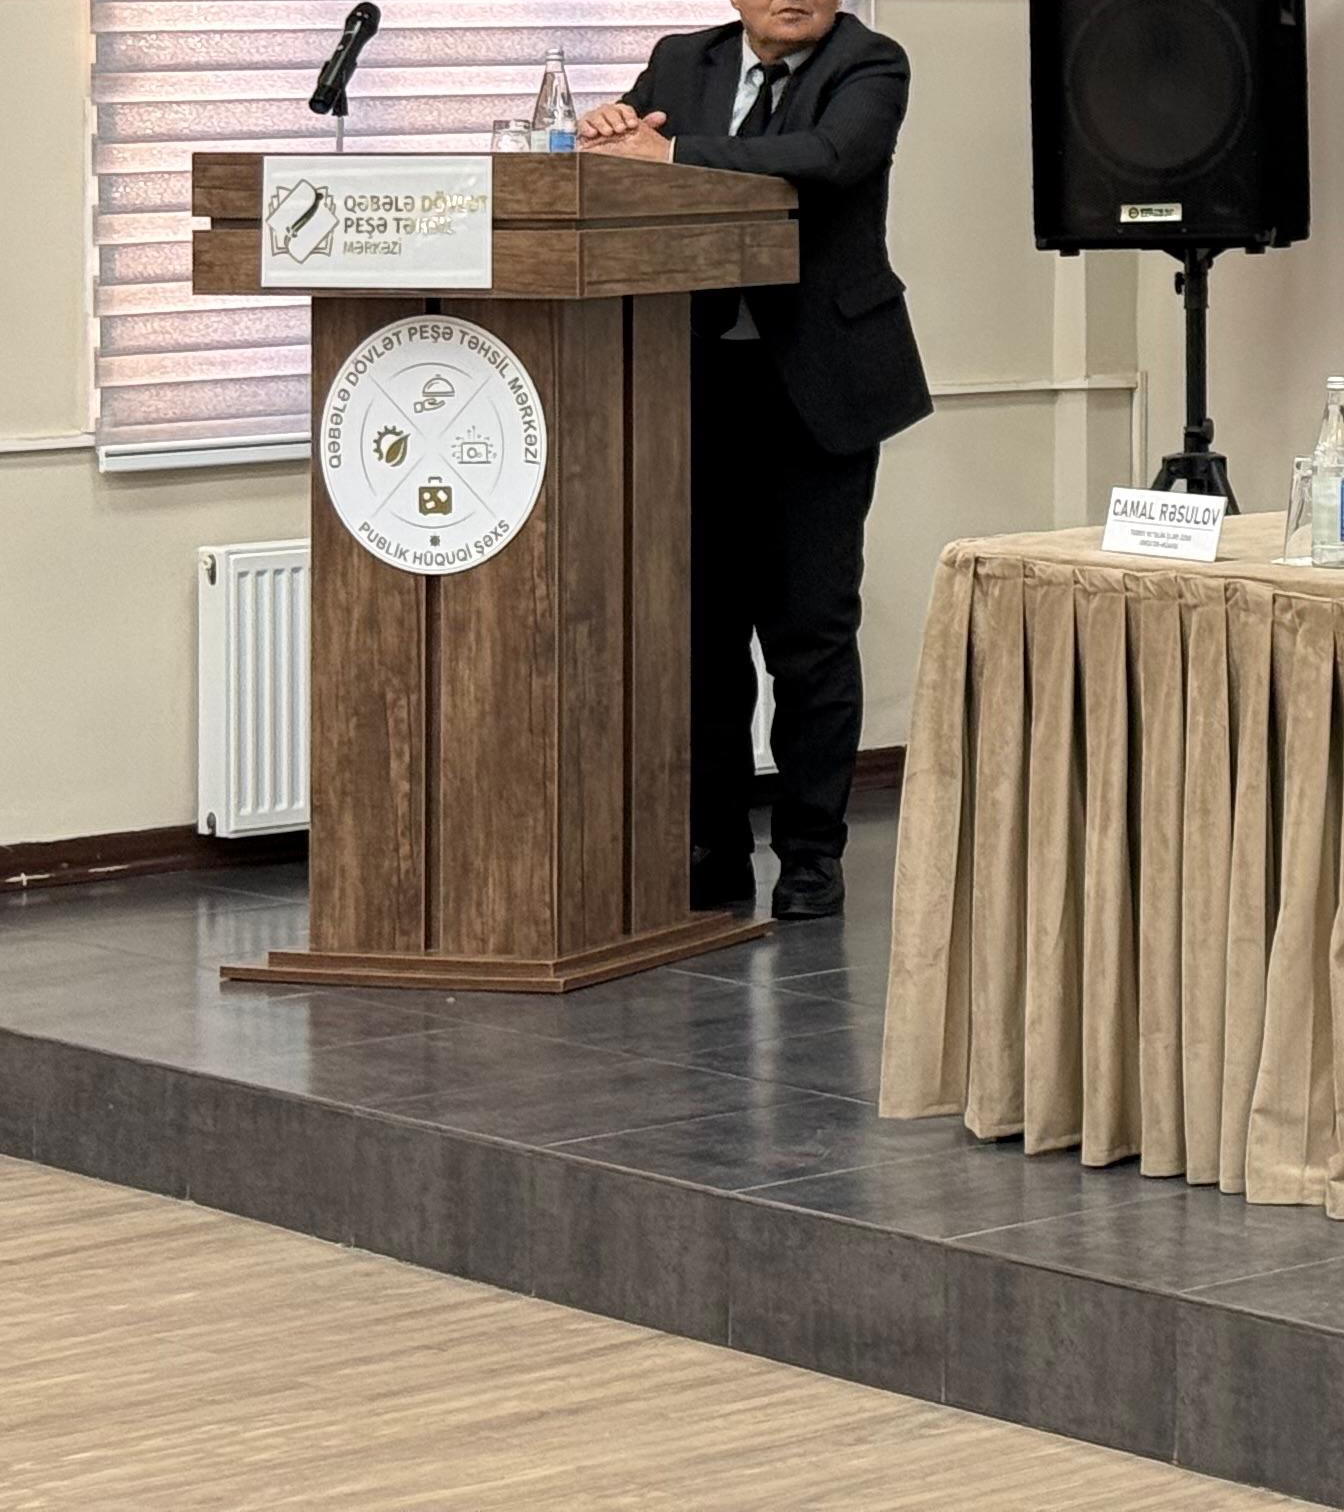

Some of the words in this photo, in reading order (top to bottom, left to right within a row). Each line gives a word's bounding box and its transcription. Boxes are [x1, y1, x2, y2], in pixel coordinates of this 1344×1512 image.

[344, 194, 415, 214] QƏBƏLƏ
[344, 216, 388, 239] PEŞƏ
[328, 388, 350, 469] QƏBƏLƏ
[346, 330, 403, 387] DÖVLƏT
[408, 324, 454, 344] PEŞƏ
[458, 329, 511, 379] TƏHSİL
[1112, 498, 1155, 521] CAMAL
[1158, 503, 1220, 527] RƏSULOV
[473, 519, 511, 555] ŞƏXS
